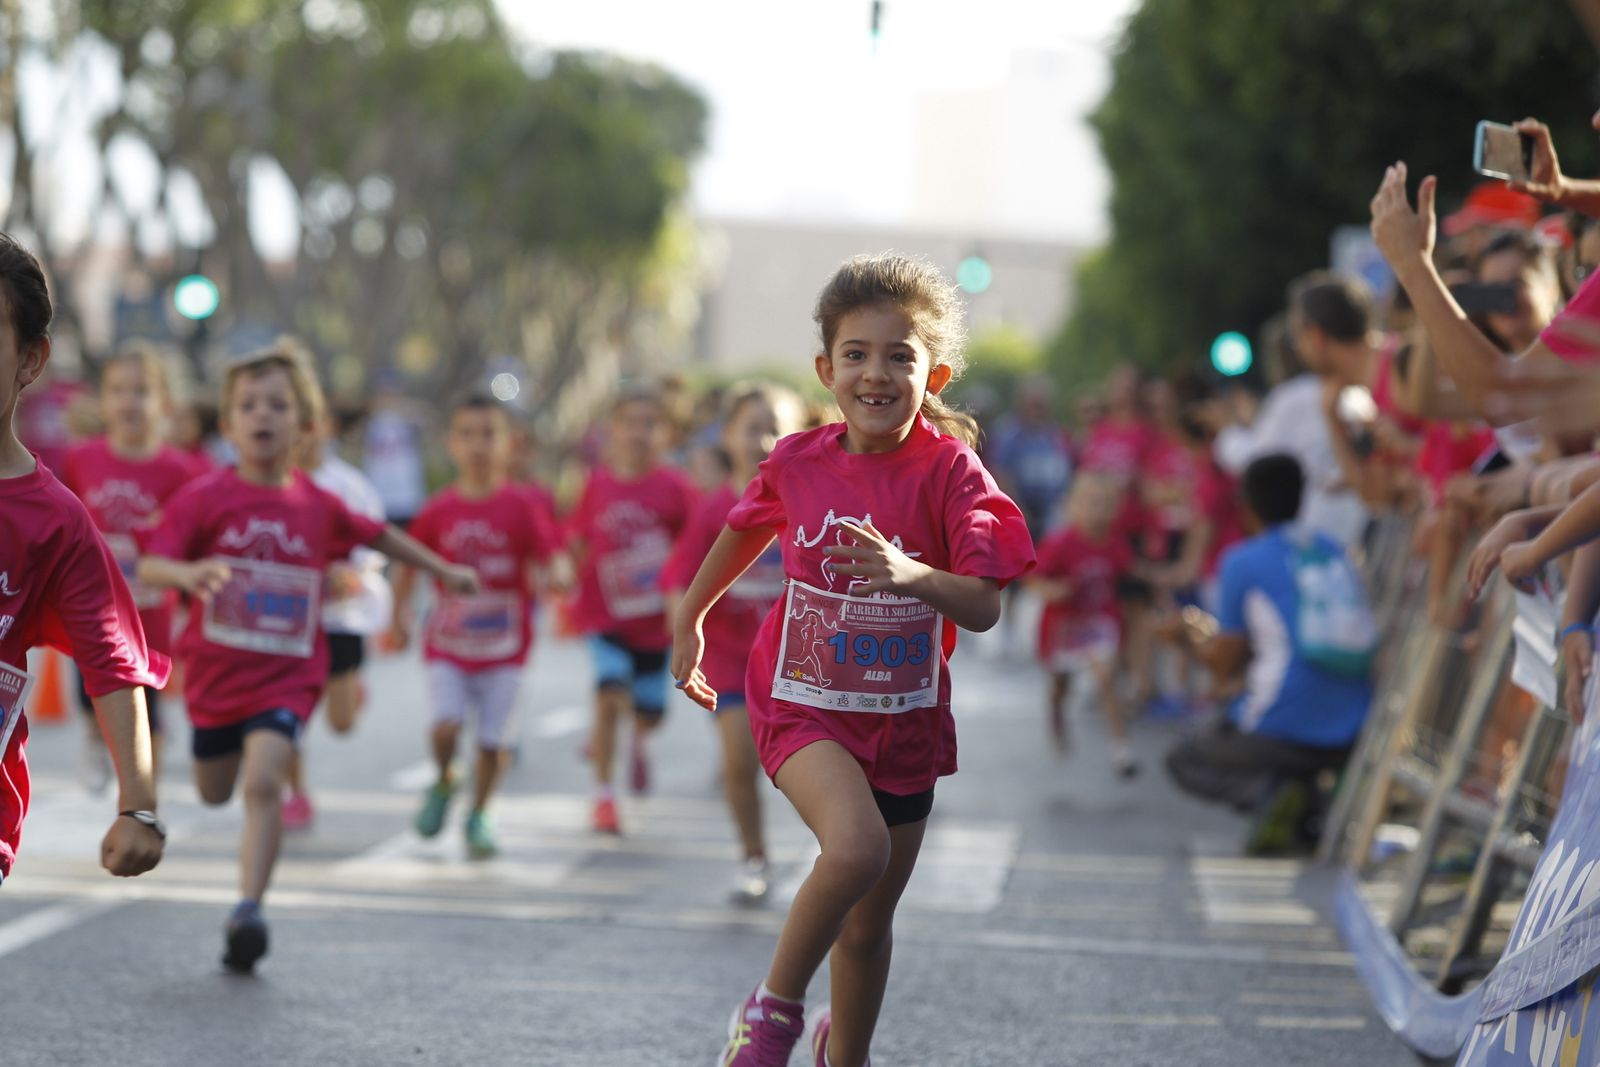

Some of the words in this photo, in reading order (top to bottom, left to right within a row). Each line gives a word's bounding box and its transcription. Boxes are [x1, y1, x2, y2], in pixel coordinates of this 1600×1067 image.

[847, 603, 889, 617] CARRERA
[891, 604, 934, 617] SOLIDARI
[828, 631, 931, 668] 1903
[802, 673, 816, 683] Salle
[863, 670, 892, 682] ALBA
